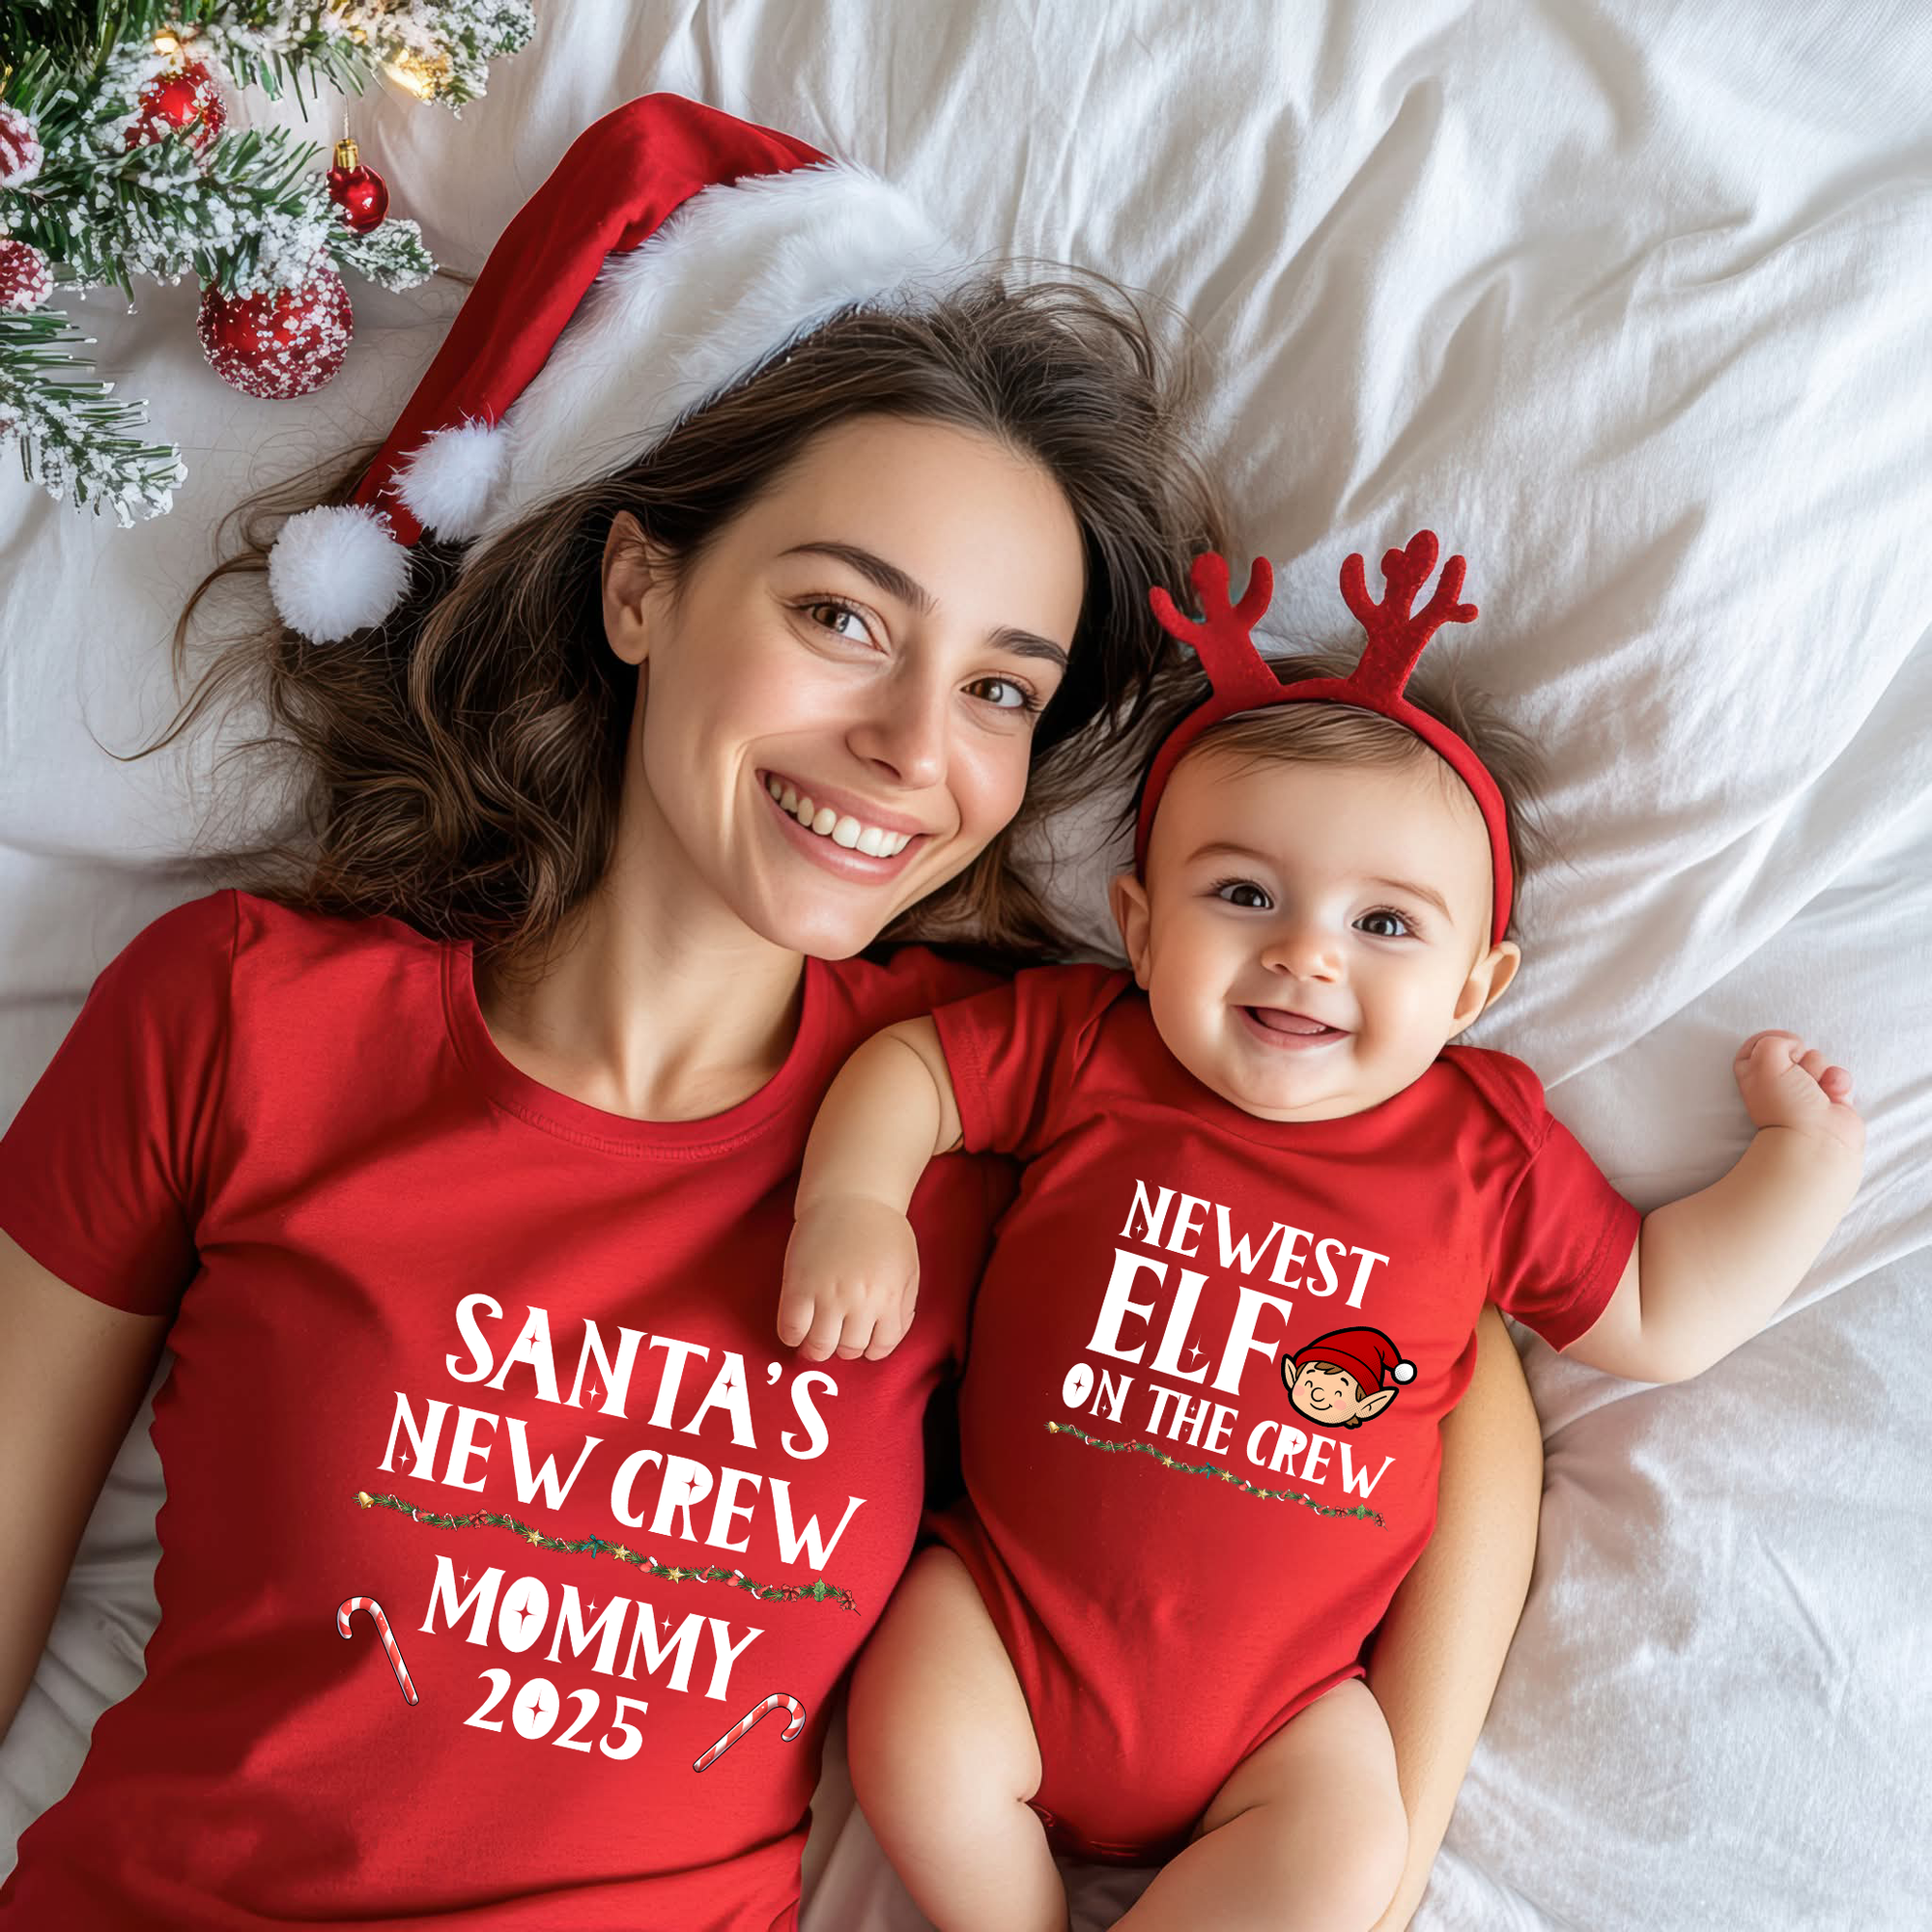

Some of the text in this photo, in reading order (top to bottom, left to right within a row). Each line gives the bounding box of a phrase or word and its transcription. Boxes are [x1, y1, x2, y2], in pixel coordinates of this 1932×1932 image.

[1119, 1179, 1390, 1310] NEWEST
[445, 1293, 838, 1461] SANTA'S
[1085, 1247, 1293, 1396] ELF
[377, 1391, 867, 1572] NEW CREW
[1062, 1362, 1396, 1499] ON THE CREW
[417, 1554, 765, 1702] MOMMY
[463, 1667, 649, 1761] 2025
